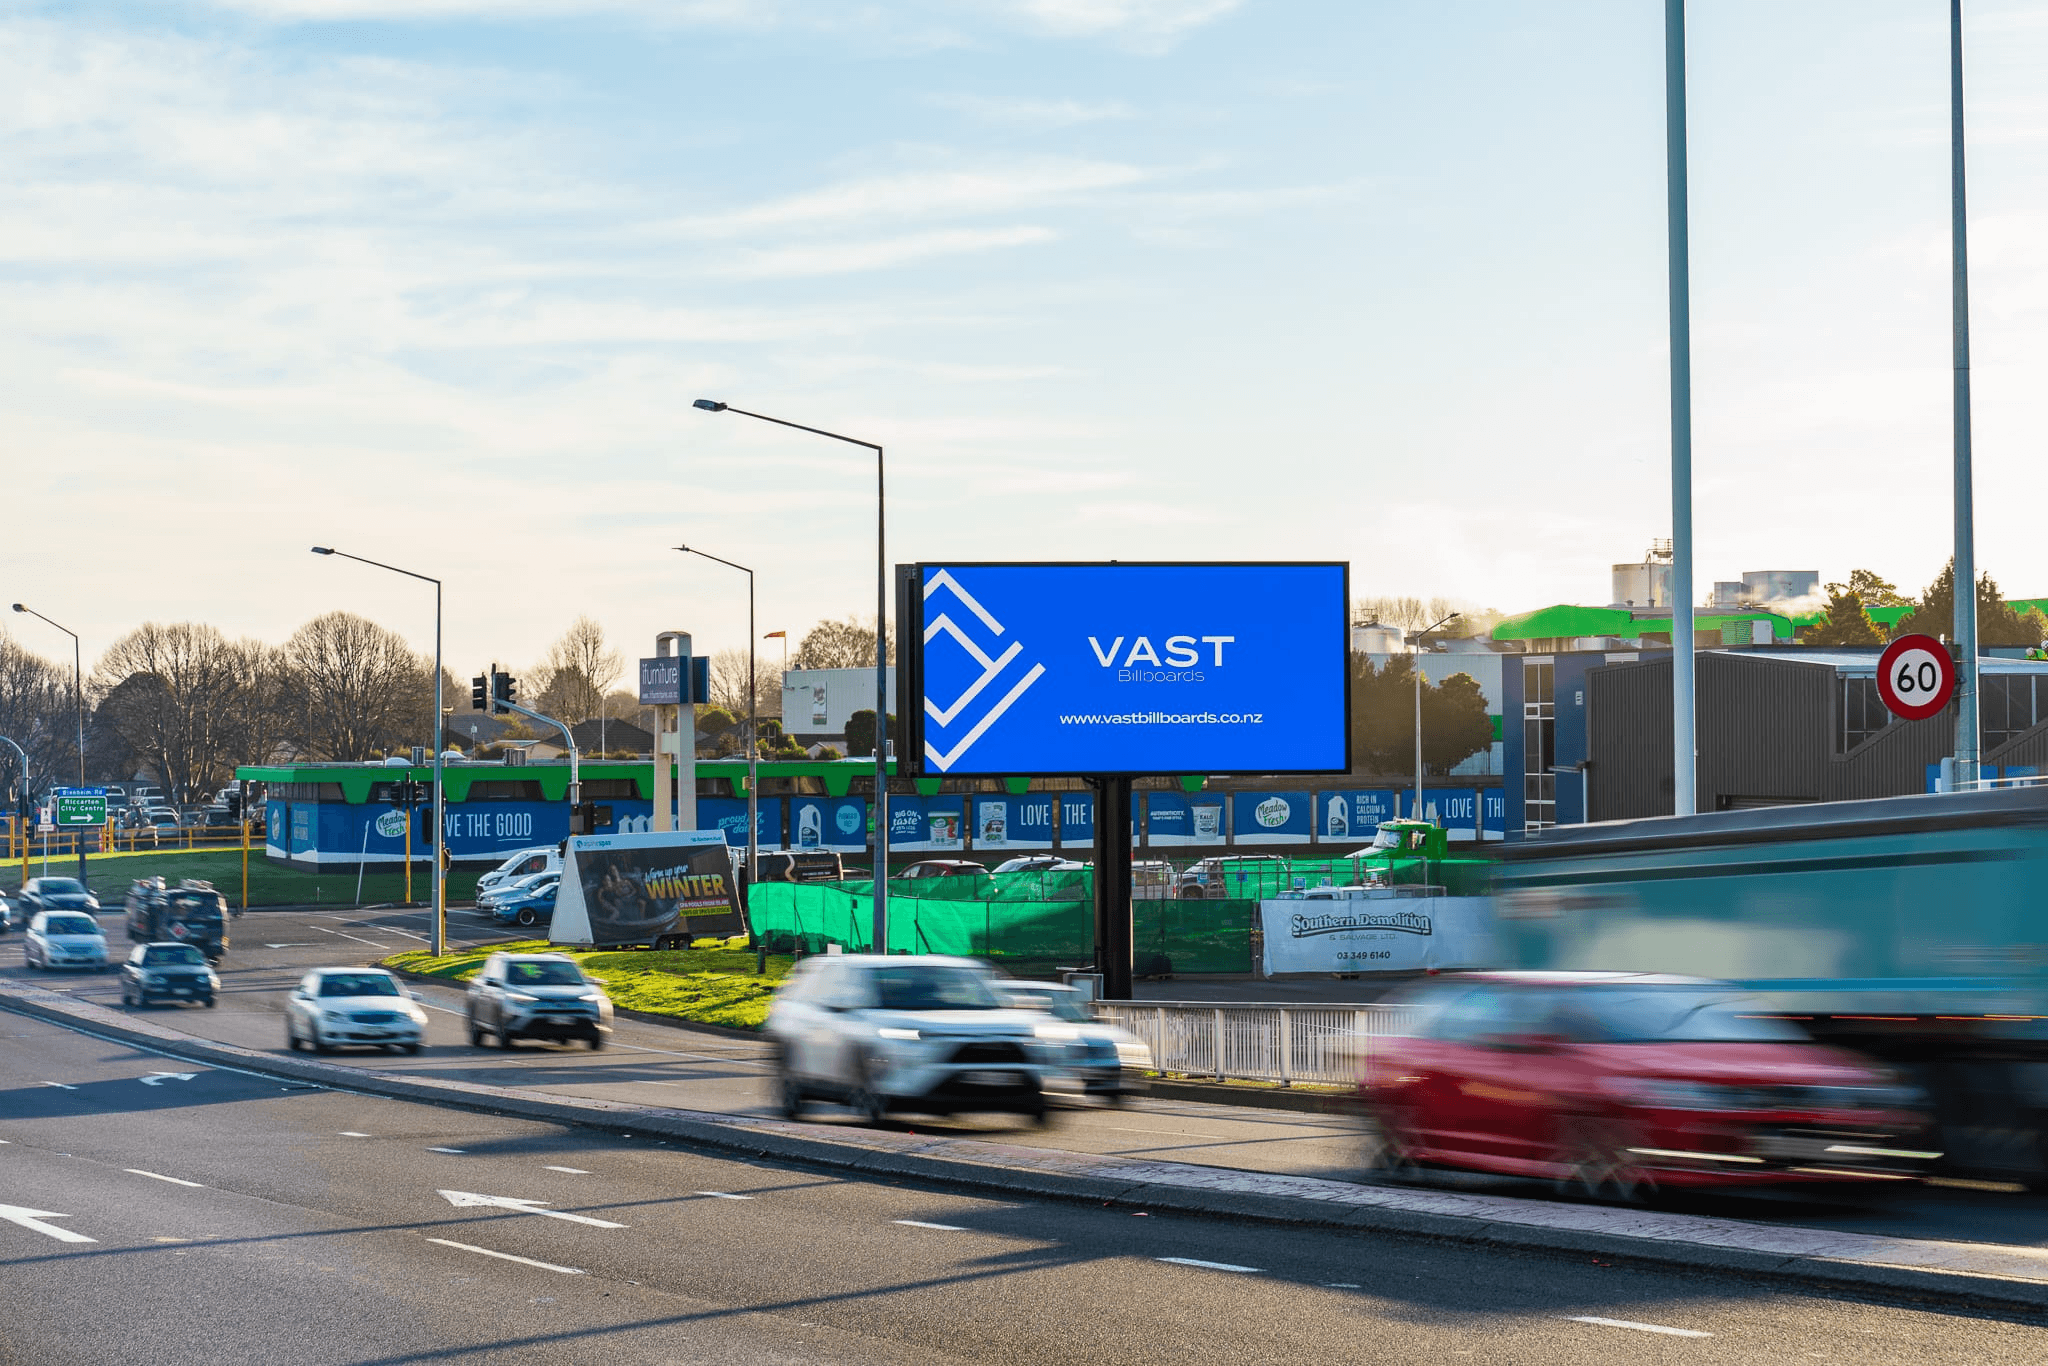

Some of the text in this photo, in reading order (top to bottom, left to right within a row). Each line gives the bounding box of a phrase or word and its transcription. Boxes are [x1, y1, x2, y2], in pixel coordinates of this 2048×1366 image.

[1087, 635, 1235, 668] VAST
[642, 663, 678, 685] ifurniture
[1118, 669, 1205, 682] Billboards
[1896, 661, 1937, 693] 60
[1059, 711, 1264, 725] www.vastbillboards.co.nz
[1356, 795, 1377, 804] RICH IN
[1445, 797, 1473, 818] LOVE
[894, 809, 918, 818] BIG ON
[1020, 803, 1087, 826] LOVE THE
[1257, 800, 1287, 819] Meadow
[1356, 805, 1380, 815] CALCIUM
[445, 812, 533, 837] VE THE GOOD
[892, 817, 919, 826] taste
[1356, 815, 1379, 825] PROTEIN
[645, 873, 728, 900] WINTER
[1291, 912, 1432, 932] Southern Demolition
[1336, 951, 1391, 960] 03 349 6140
